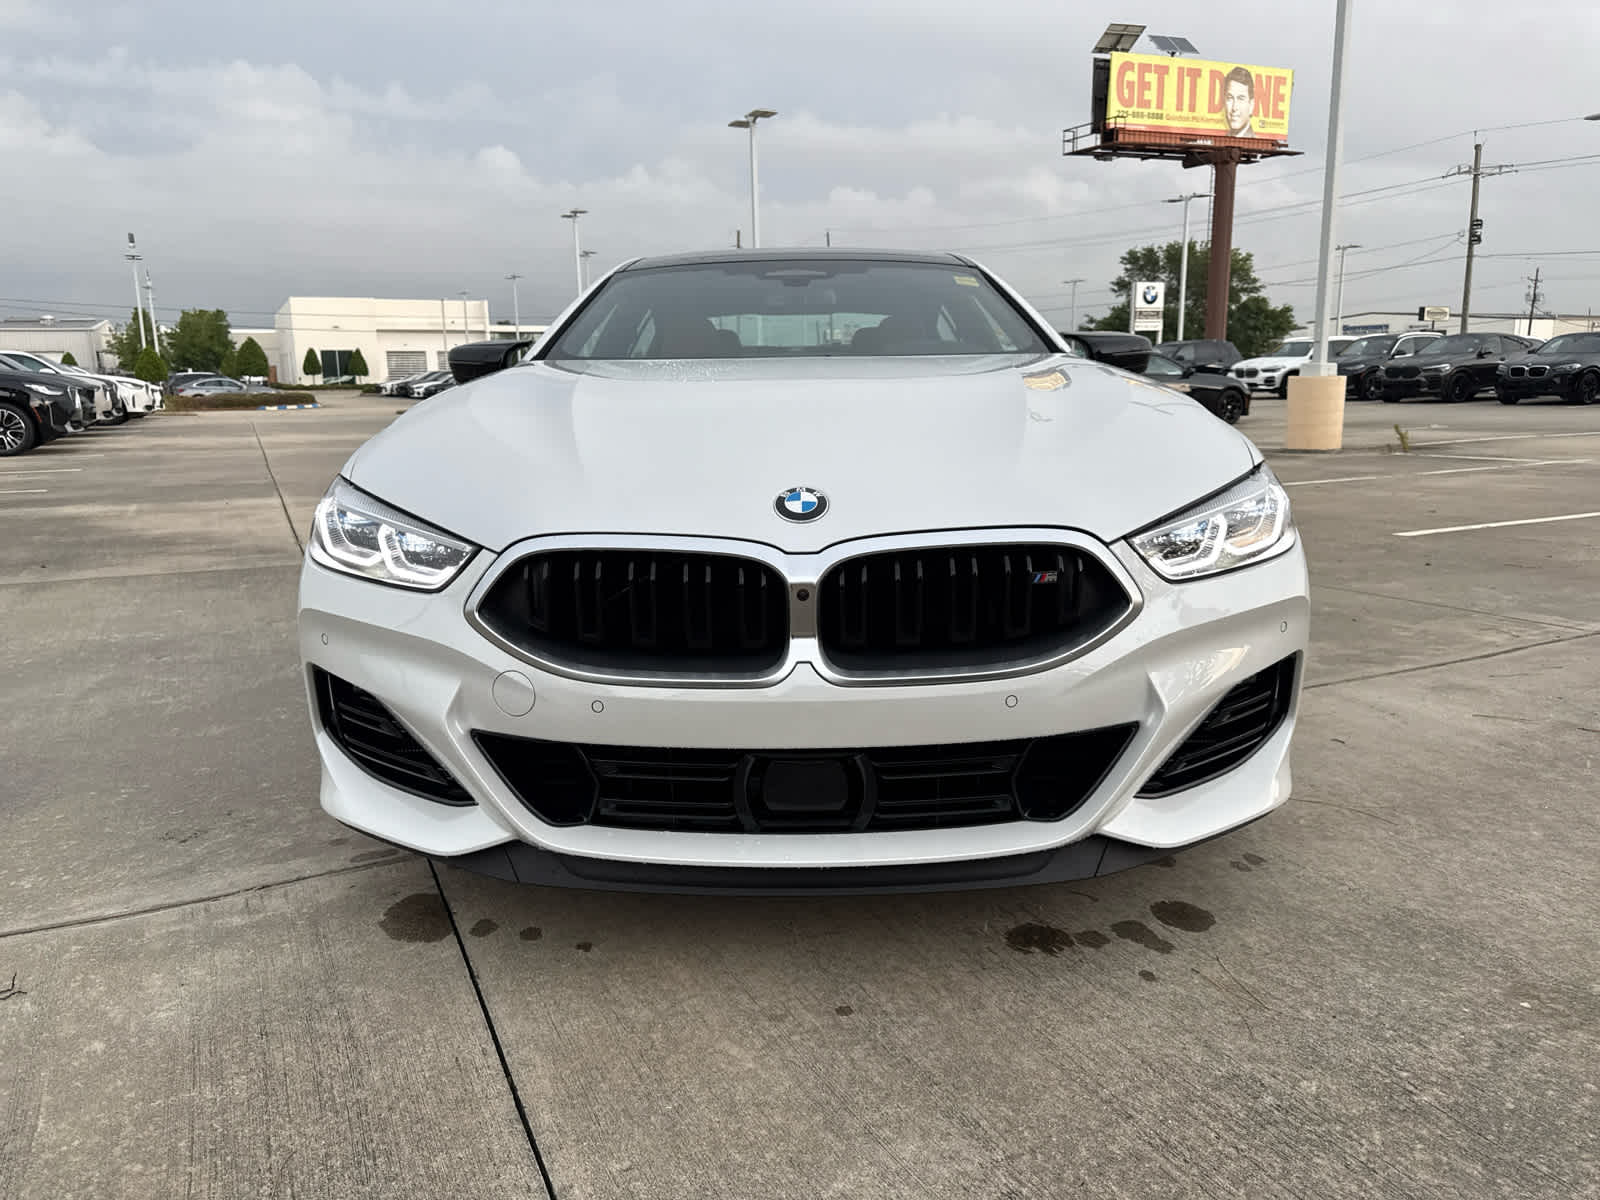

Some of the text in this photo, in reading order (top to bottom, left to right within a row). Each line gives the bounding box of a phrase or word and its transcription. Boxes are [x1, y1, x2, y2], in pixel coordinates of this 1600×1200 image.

[1116, 60, 1287, 120] GET IT DNE
